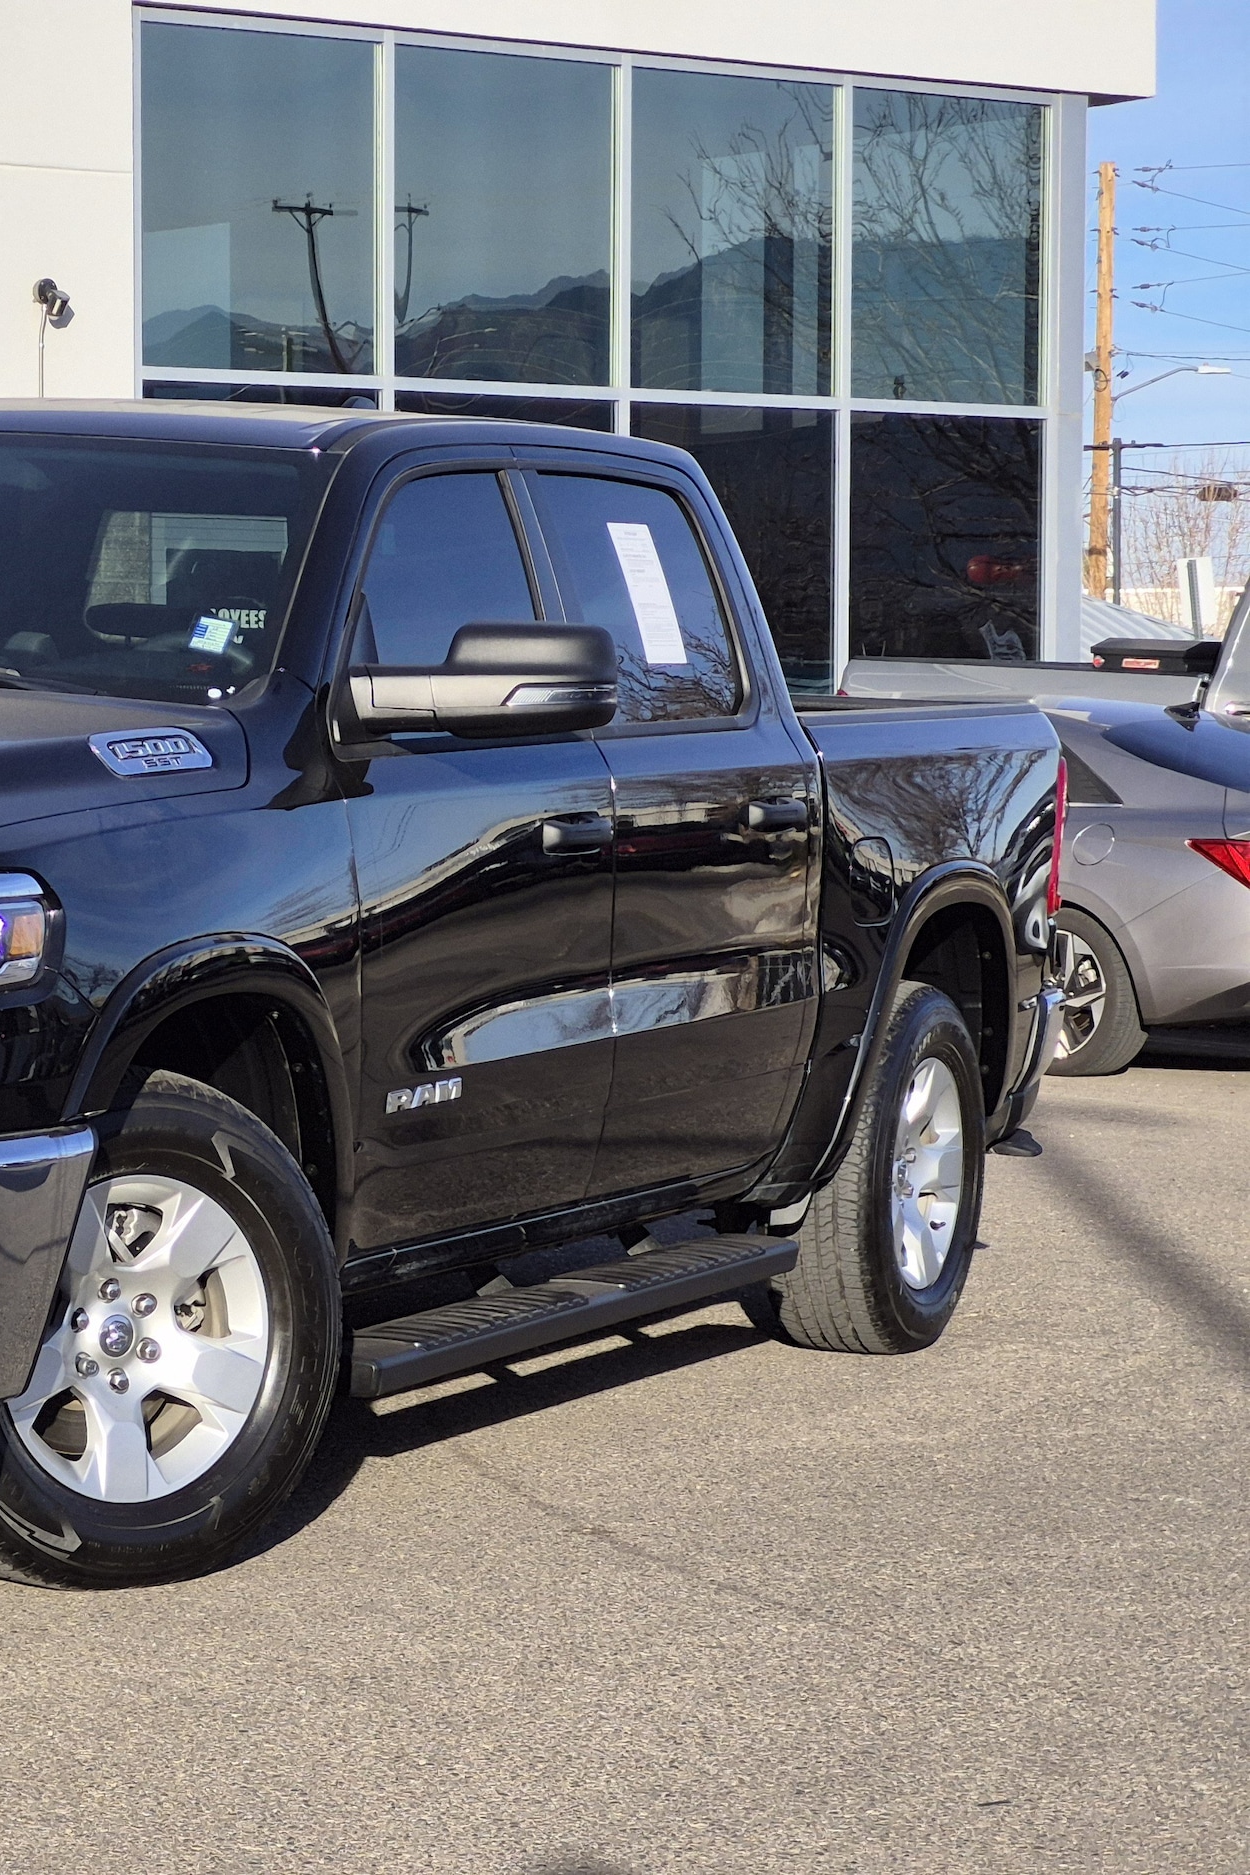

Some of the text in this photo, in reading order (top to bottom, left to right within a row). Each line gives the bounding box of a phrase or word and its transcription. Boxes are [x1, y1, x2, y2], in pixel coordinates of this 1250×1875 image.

[210, 608, 267, 629] OYEES
[109, 737, 191, 760] 1500
[142, 756, 183, 769] SST
[385, 1077, 463, 1114] RAM
